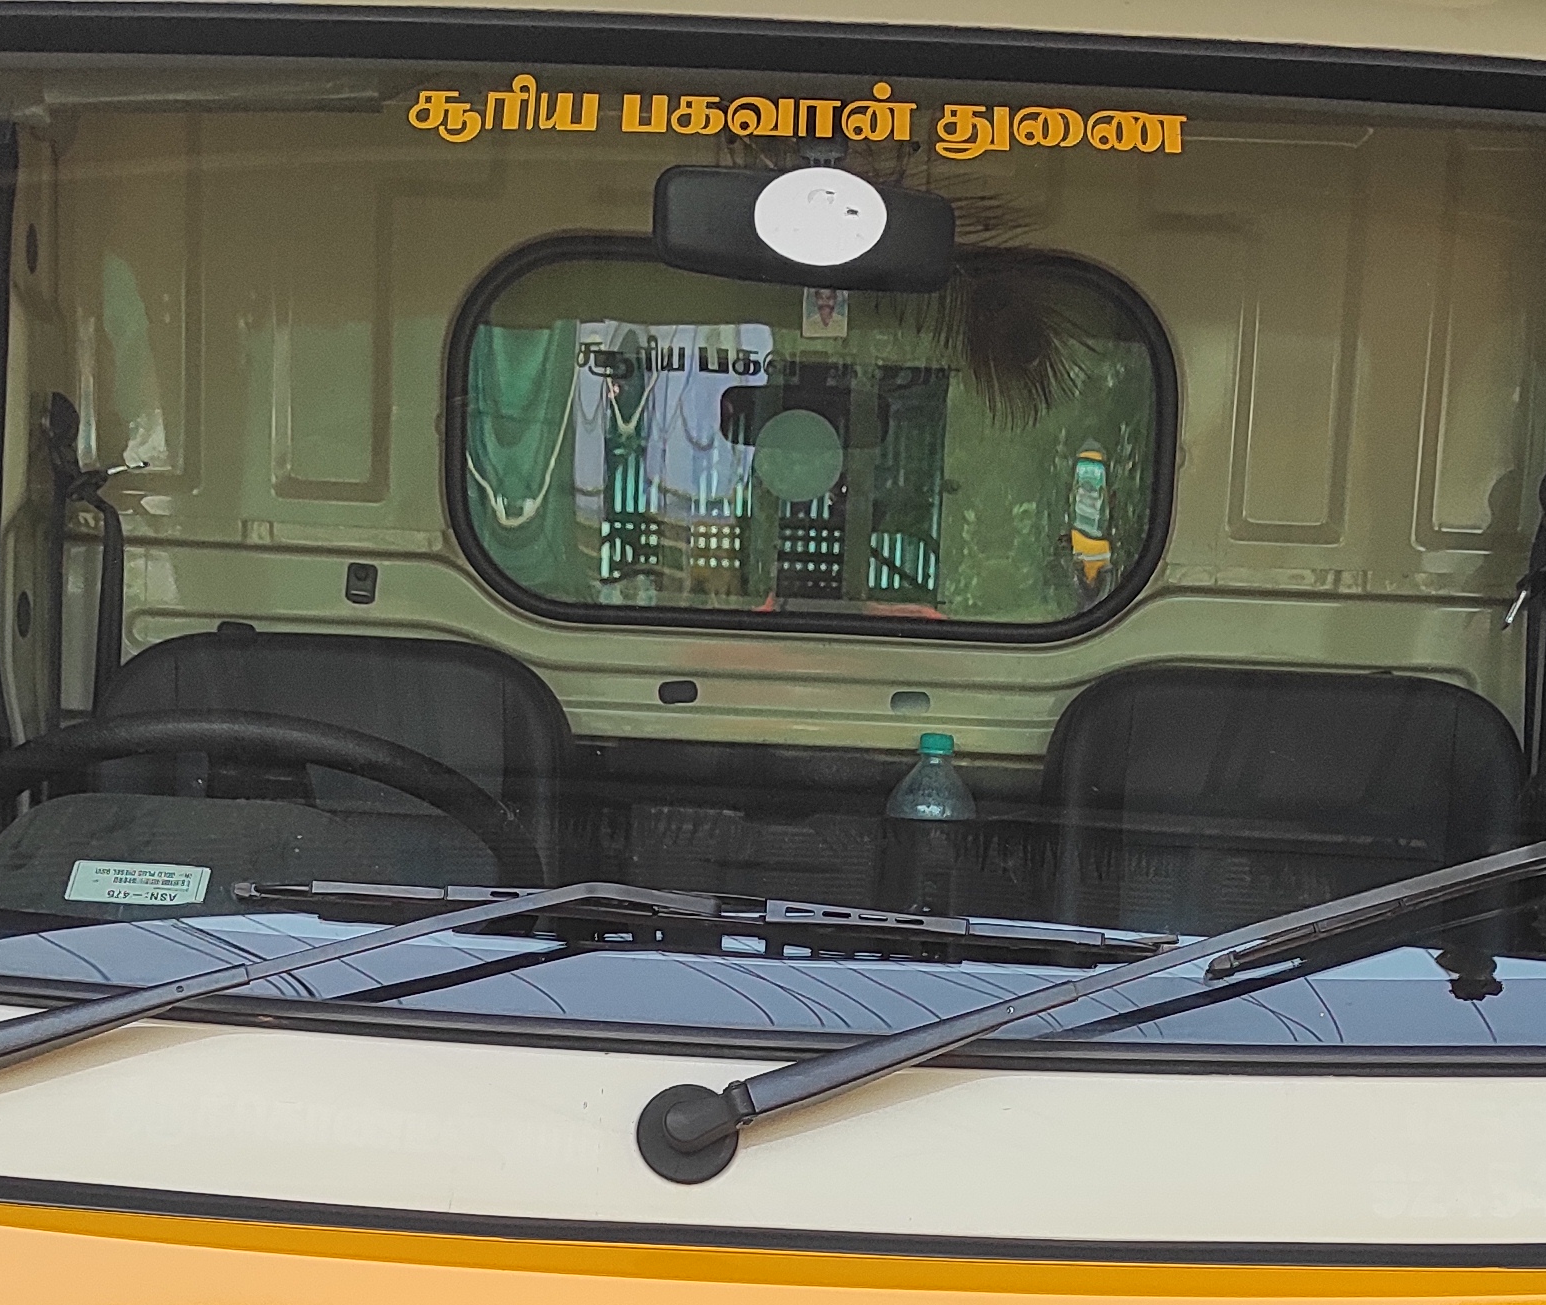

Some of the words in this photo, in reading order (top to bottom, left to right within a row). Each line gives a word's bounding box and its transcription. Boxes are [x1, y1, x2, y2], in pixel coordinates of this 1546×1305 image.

[408, 75, 598, 143] சூரிய
[622, 82, 916, 141] பகவான்
[935, 103, 1188, 159] துணை
